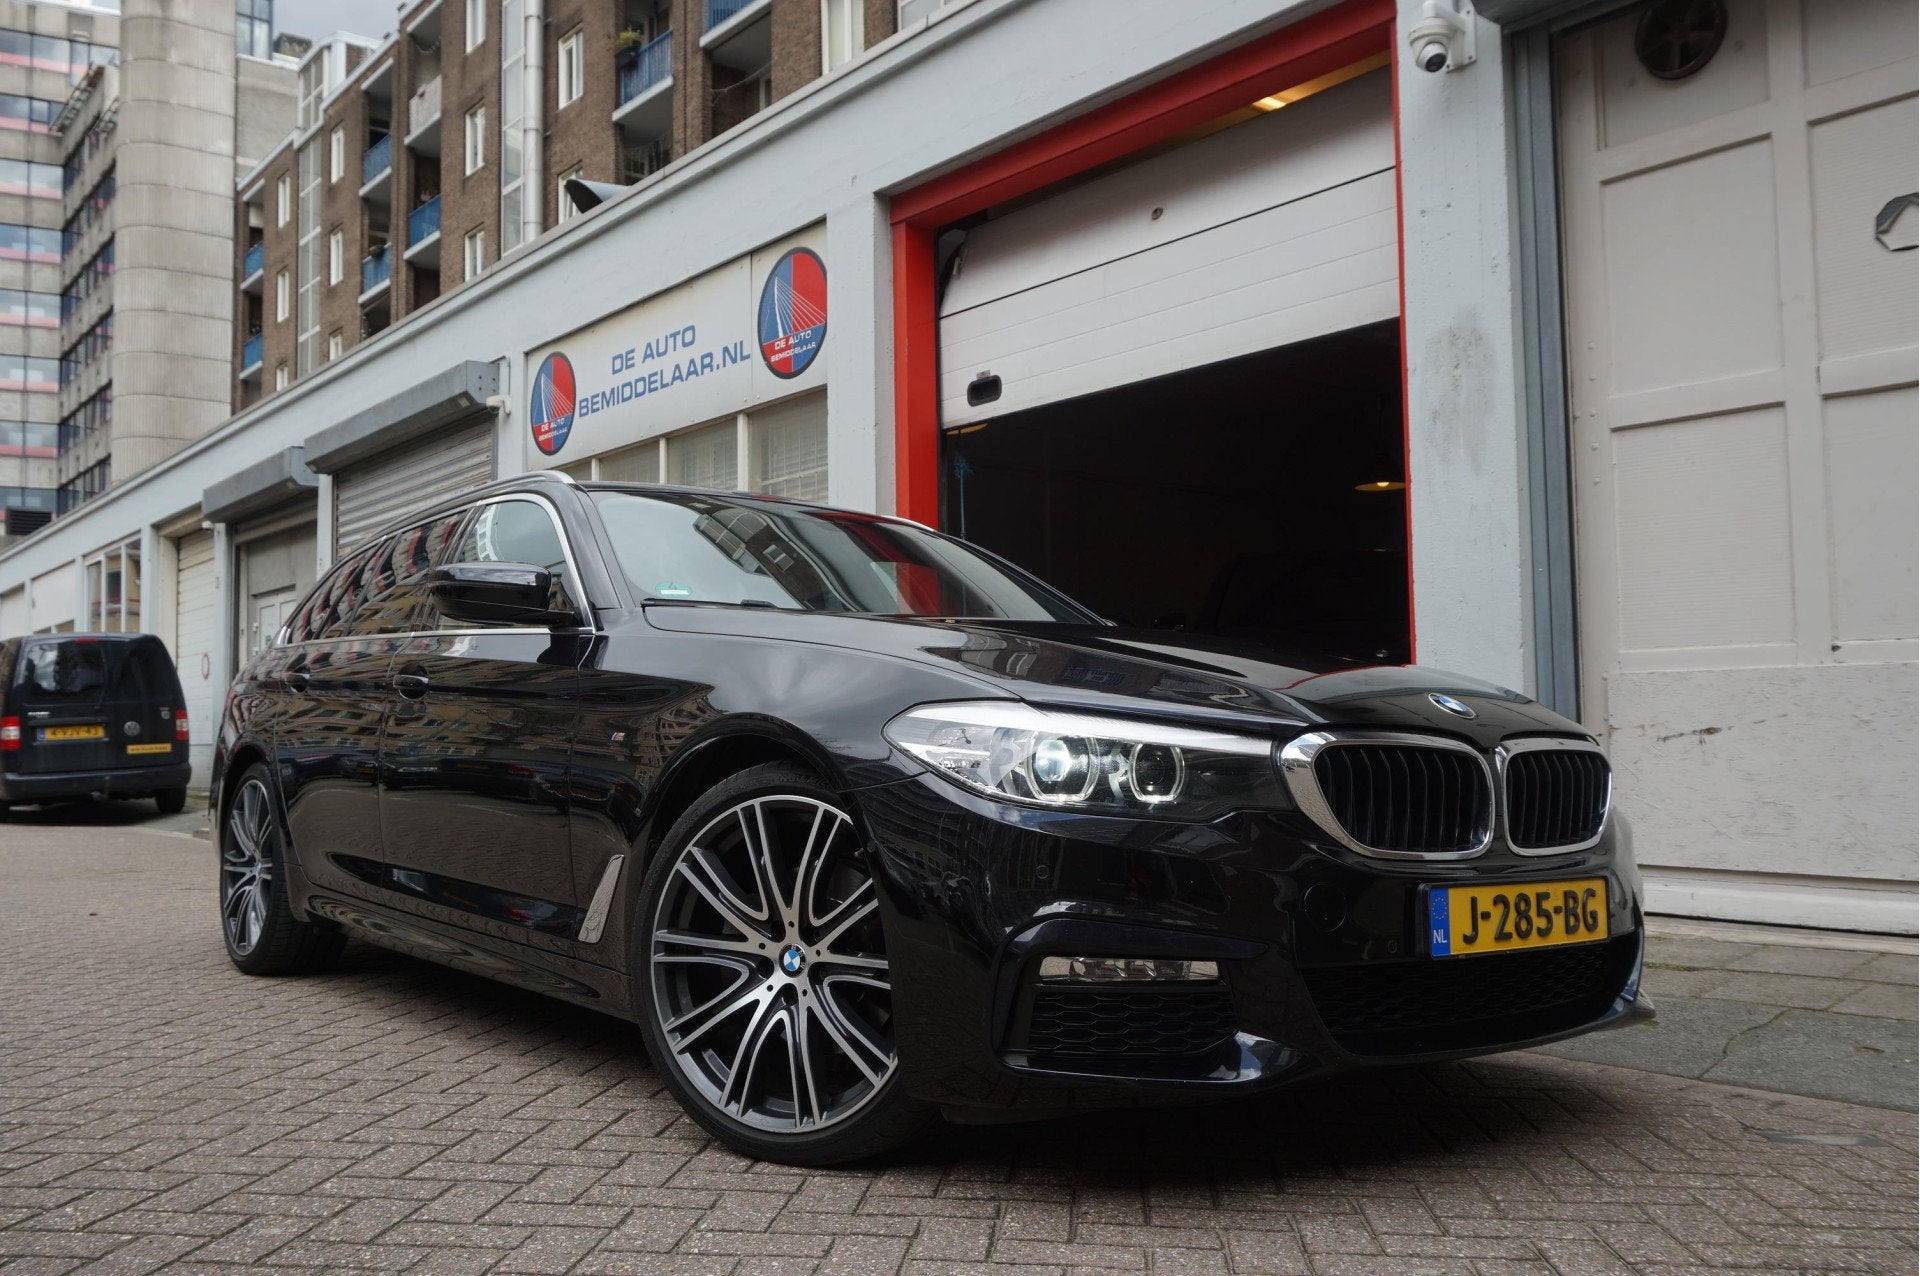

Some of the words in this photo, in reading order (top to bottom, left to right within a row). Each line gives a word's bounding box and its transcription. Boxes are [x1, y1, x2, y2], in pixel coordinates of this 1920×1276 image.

[611, 343, 636, 375] DE
[641, 324, 697, 364] AUTO
[774, 338, 787, 350] DE
[788, 329, 812, 346] AUTO
[578, 340, 750, 418] BEMIDDELAAR.NL
[1433, 929, 1448, 944] NL
[1462, 888, 1599, 944] J-285-BG
